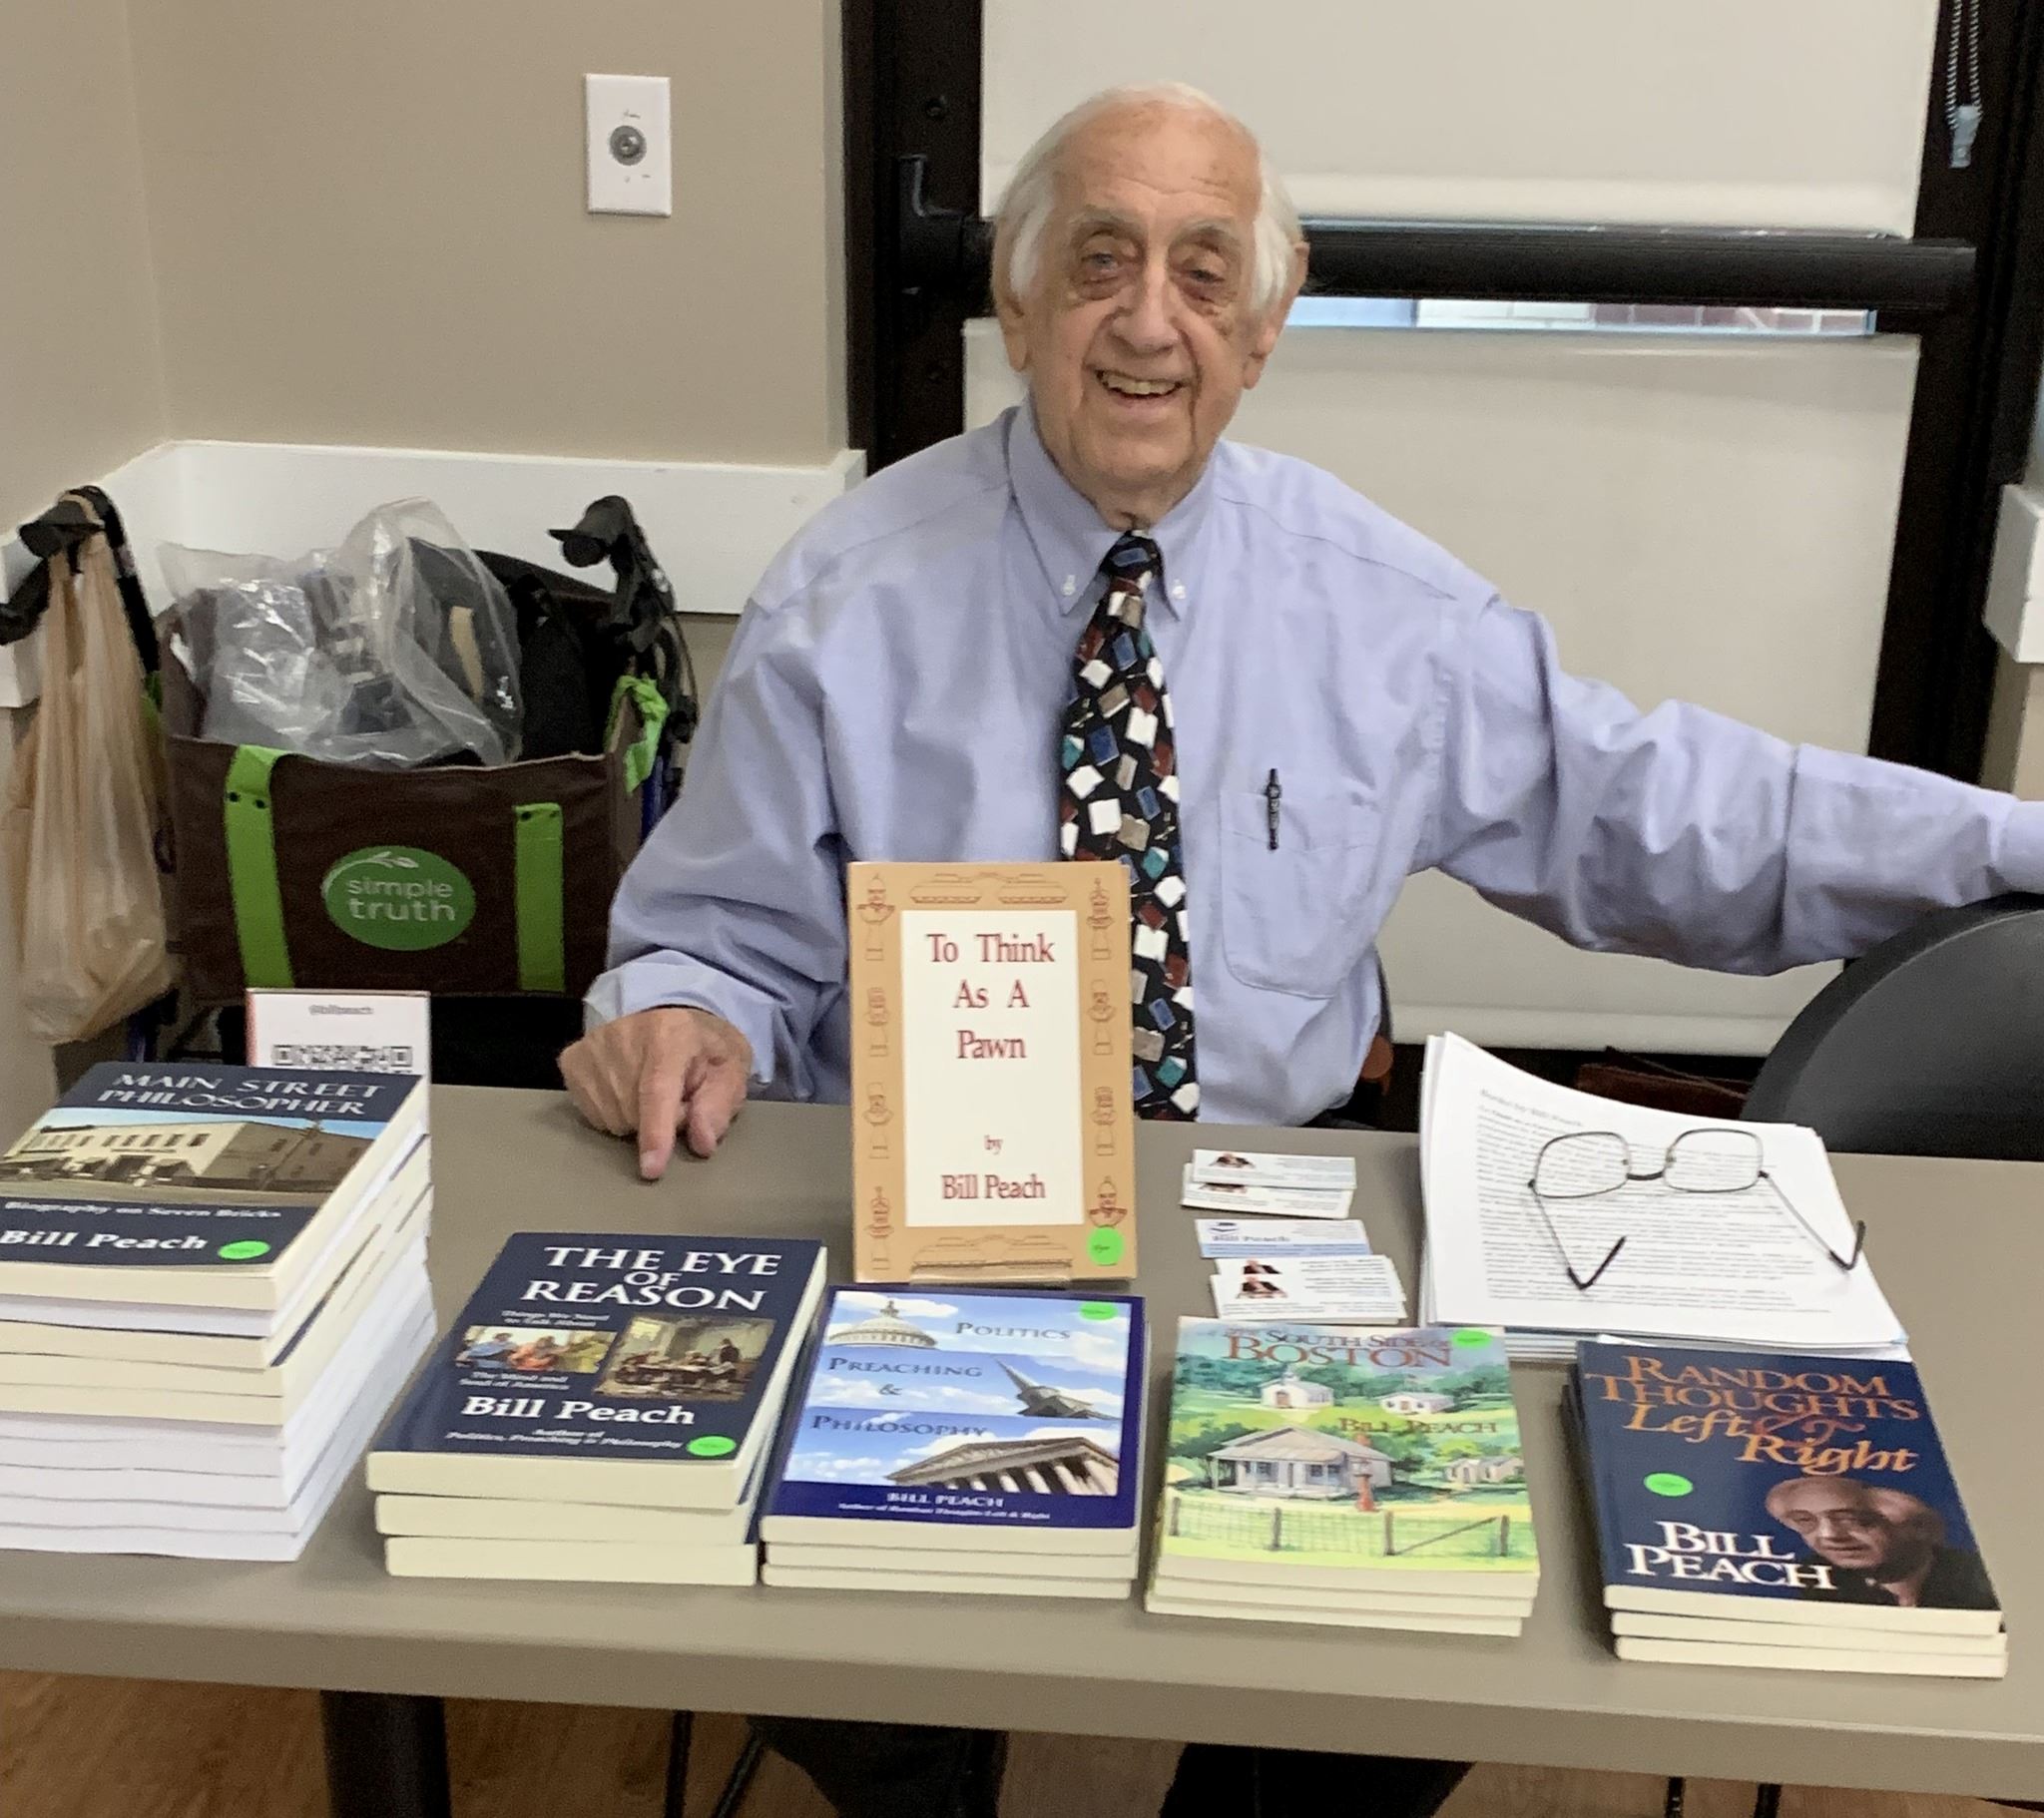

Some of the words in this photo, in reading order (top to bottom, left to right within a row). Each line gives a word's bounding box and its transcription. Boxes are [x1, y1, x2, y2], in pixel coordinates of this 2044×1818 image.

[348, 875, 454, 900] simple
[348, 898, 456, 922] truth
[924, 933, 959, 963] To
[973, 932, 1056, 963] Think
[952, 978, 990, 1009] As
[1007, 979, 1030, 1008] A
[955, 1029, 1027, 1060] Pawn
[112, 1073, 224, 1090] MAIN
[237, 1079, 386, 1099] STREET
[99, 1089, 366, 1115] PHILOSOPHER
[983, 1134, 1004, 1155] by
[940, 1173, 979, 1199] Bill
[983, 1172, 1046, 1199] Peach
[0, 1229, 79, 1246] Bill
[85, 1232, 209, 1249] Peach
[544, 1246, 666, 1270] THE
[680, 1251, 782, 1275] EYE
[623, 1270, 683, 1286] OF
[520, 1279, 767, 1311] REASON
[955, 1321, 1071, 1340] POLITICS
[1265, 1329, 1363, 1347] SOUTH
[1222, 1333, 1452, 1368] BOSTON
[828, 1357, 983, 1377] PREACHING
[1622, 1355, 1892, 1397] RANDOM
[877, 1383, 903, 1397] &
[1583, 1372, 1920, 1420] THOUGHTS
[461, 1395, 547, 1418] Bill
[554, 1400, 696, 1425] Peach
[1622, 1403, 1754, 1443] Left
[809, 1414, 988, 1437] PHILOSOPHY
[1405, 1420, 1497, 1434] PEACH
[1734, 1434, 1920, 1476] Right
[887, 1492, 932, 1505] BILL
[935, 1495, 1004, 1508] PEACH
[1654, 1520, 1796, 1561] BILL
[1622, 1543, 1839, 1591] PEACH
